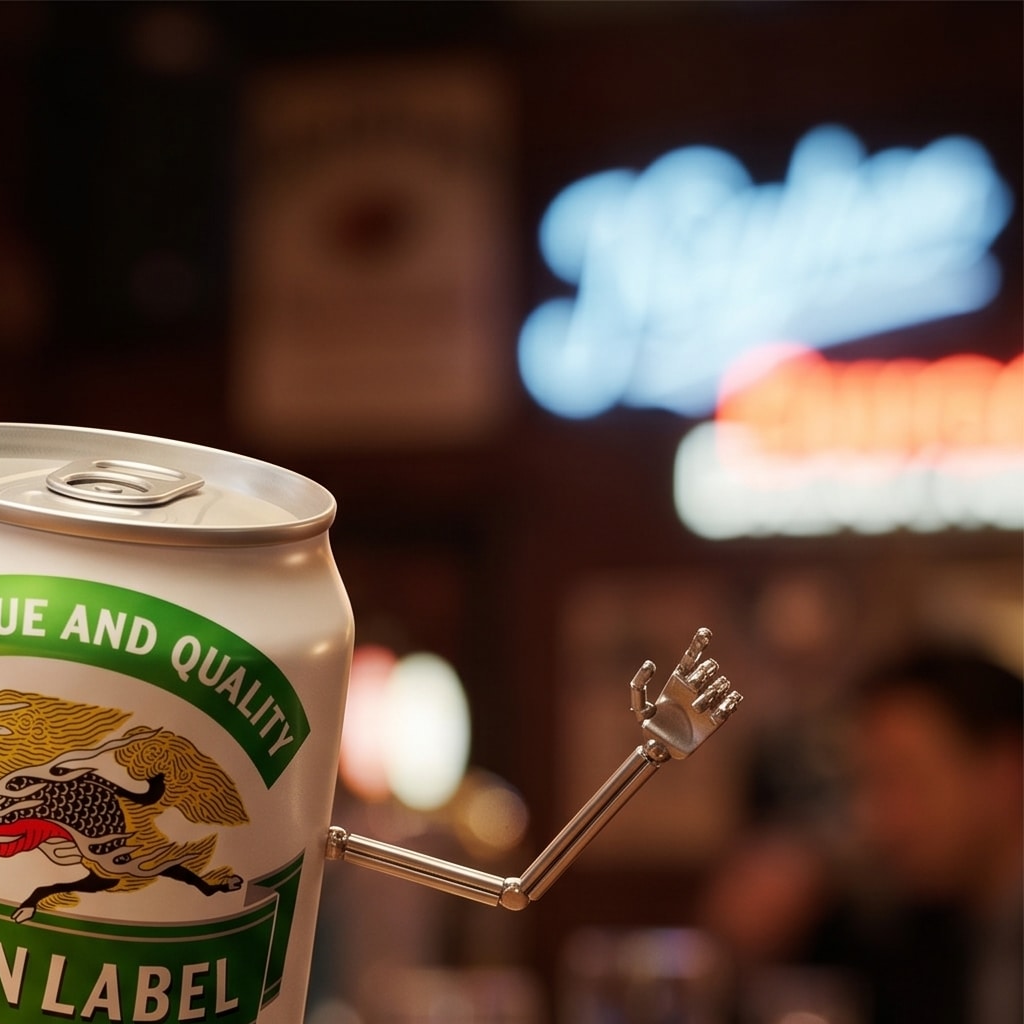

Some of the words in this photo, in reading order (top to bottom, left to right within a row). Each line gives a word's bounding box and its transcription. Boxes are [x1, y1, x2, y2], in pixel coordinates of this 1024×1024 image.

[60, 605, 158, 656] AND
[170, 634, 294, 758] QUALITY
[40, 953, 239, 1024] LABEL
